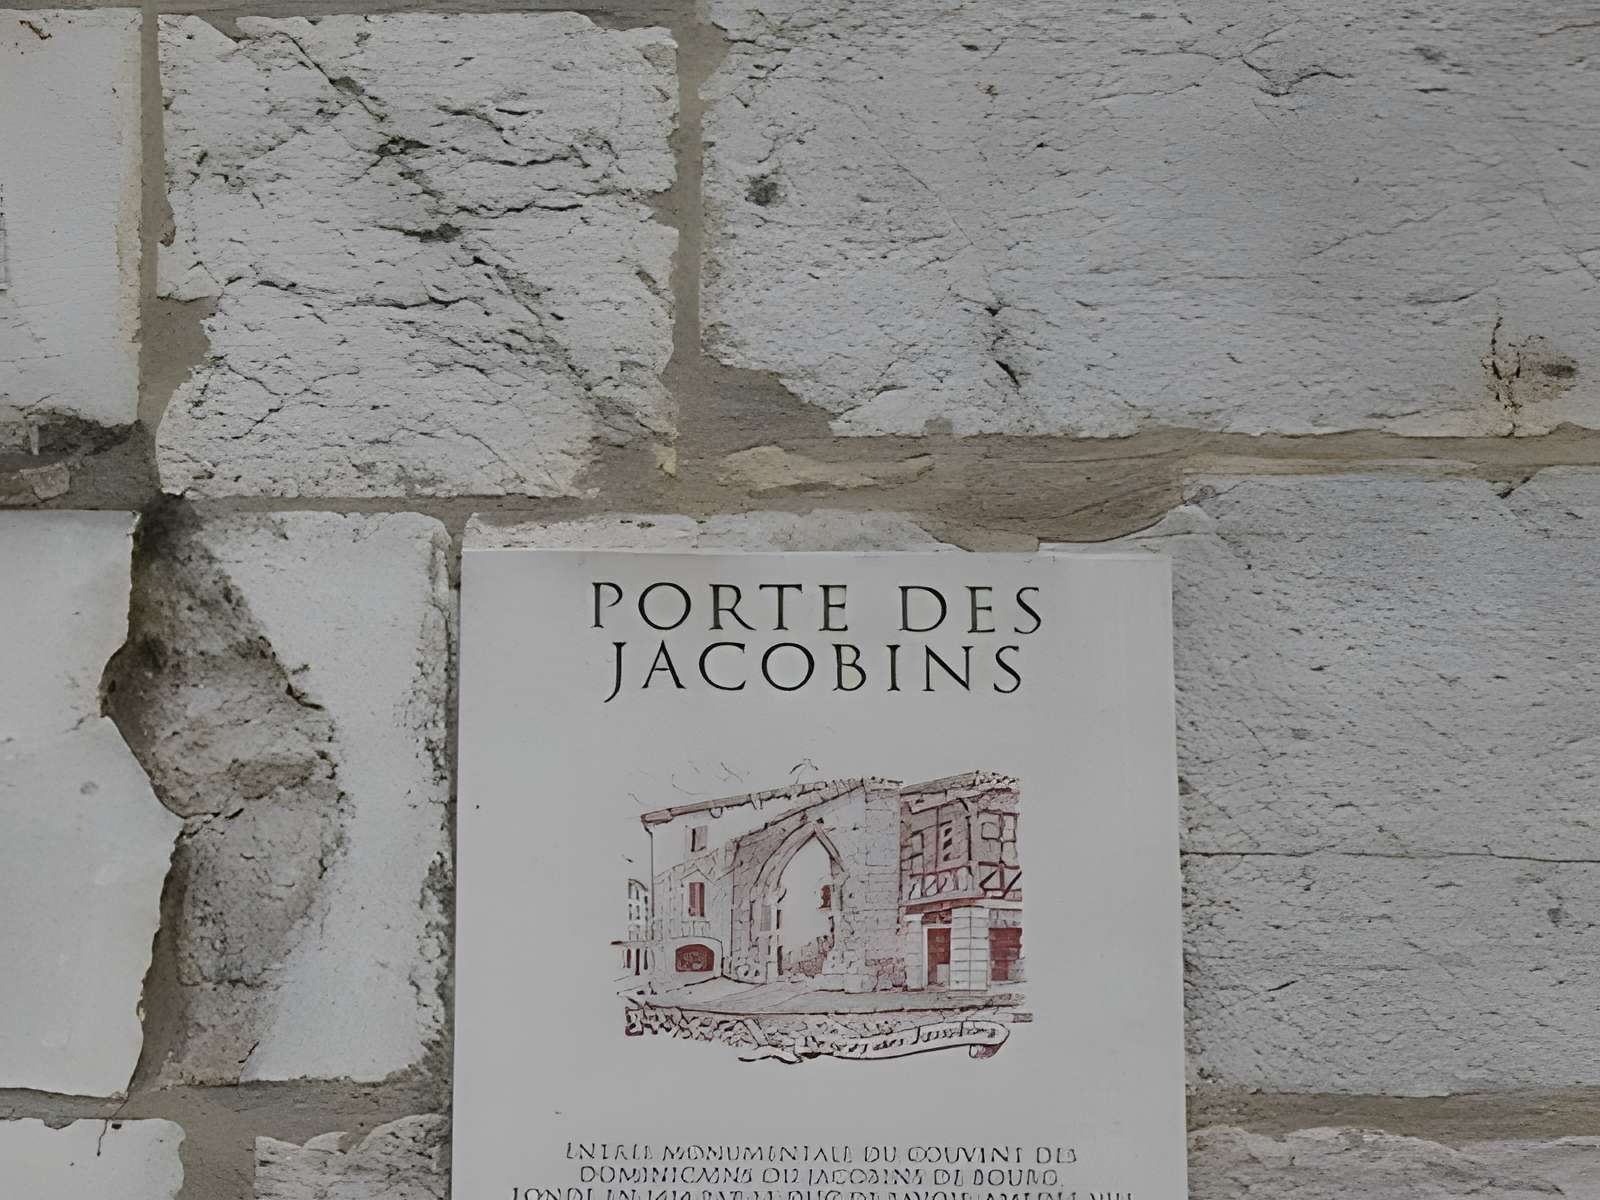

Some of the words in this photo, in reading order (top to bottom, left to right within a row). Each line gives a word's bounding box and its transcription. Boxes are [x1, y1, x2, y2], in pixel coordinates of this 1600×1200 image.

[591, 581, 849, 632] PORTE
[897, 584, 1043, 636] DES
[604, 639, 1023, 704] JACOBINS
[864, 1144, 898, 1163] DU
